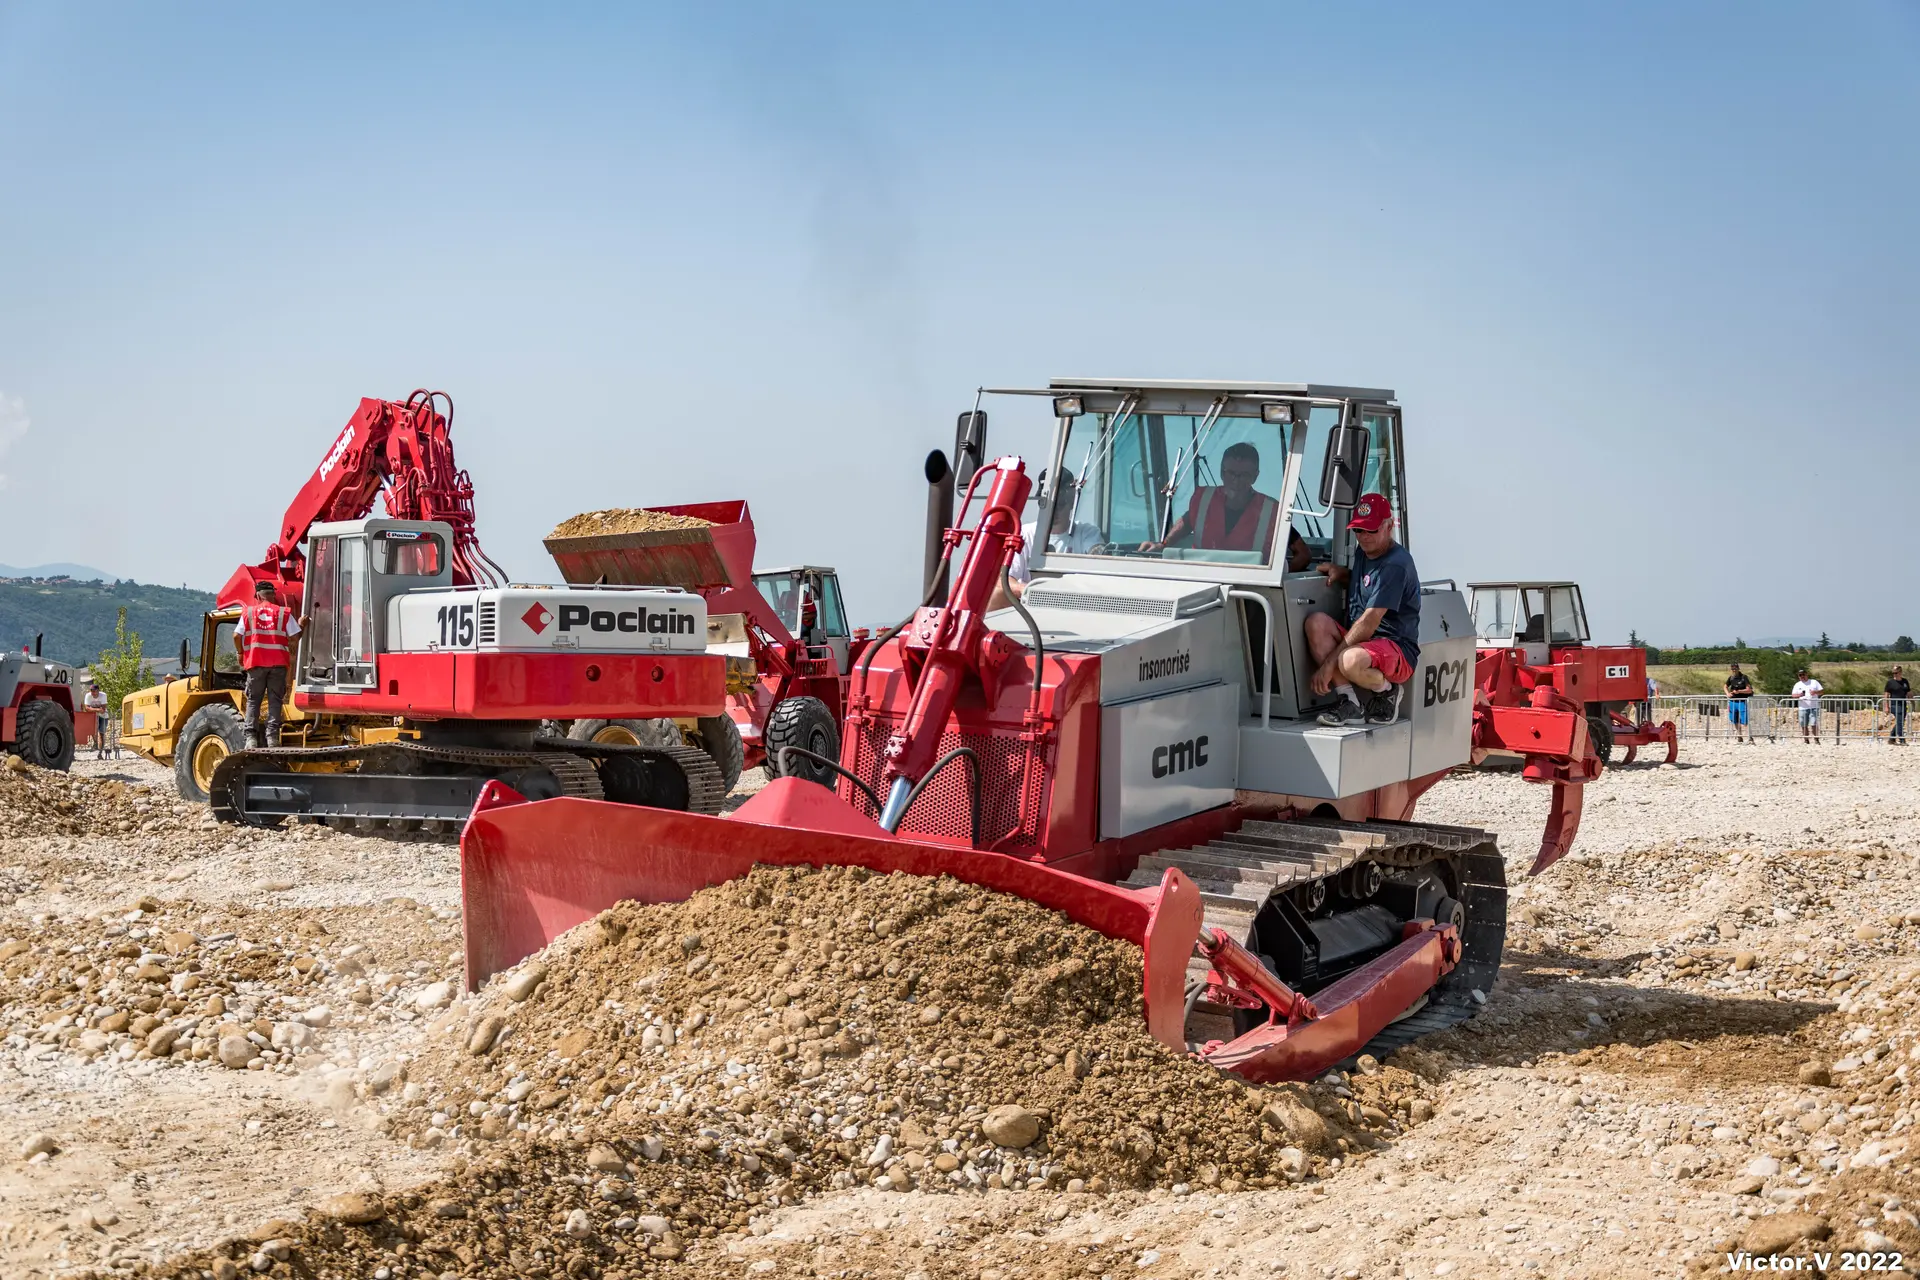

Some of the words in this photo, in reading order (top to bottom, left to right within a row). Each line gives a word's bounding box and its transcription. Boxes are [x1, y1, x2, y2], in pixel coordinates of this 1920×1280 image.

[319, 424, 356, 483] Poclain
[437, 604, 474, 647] 115
[558, 605, 694, 634] Poclain
[1139, 648, 1190, 682] insonorisé
[1423, 658, 1468, 708] BC21
[1608, 668, 1616, 676] C
[1619, 667, 1627, 676] 11
[1151, 735, 1209, 779] cmc
